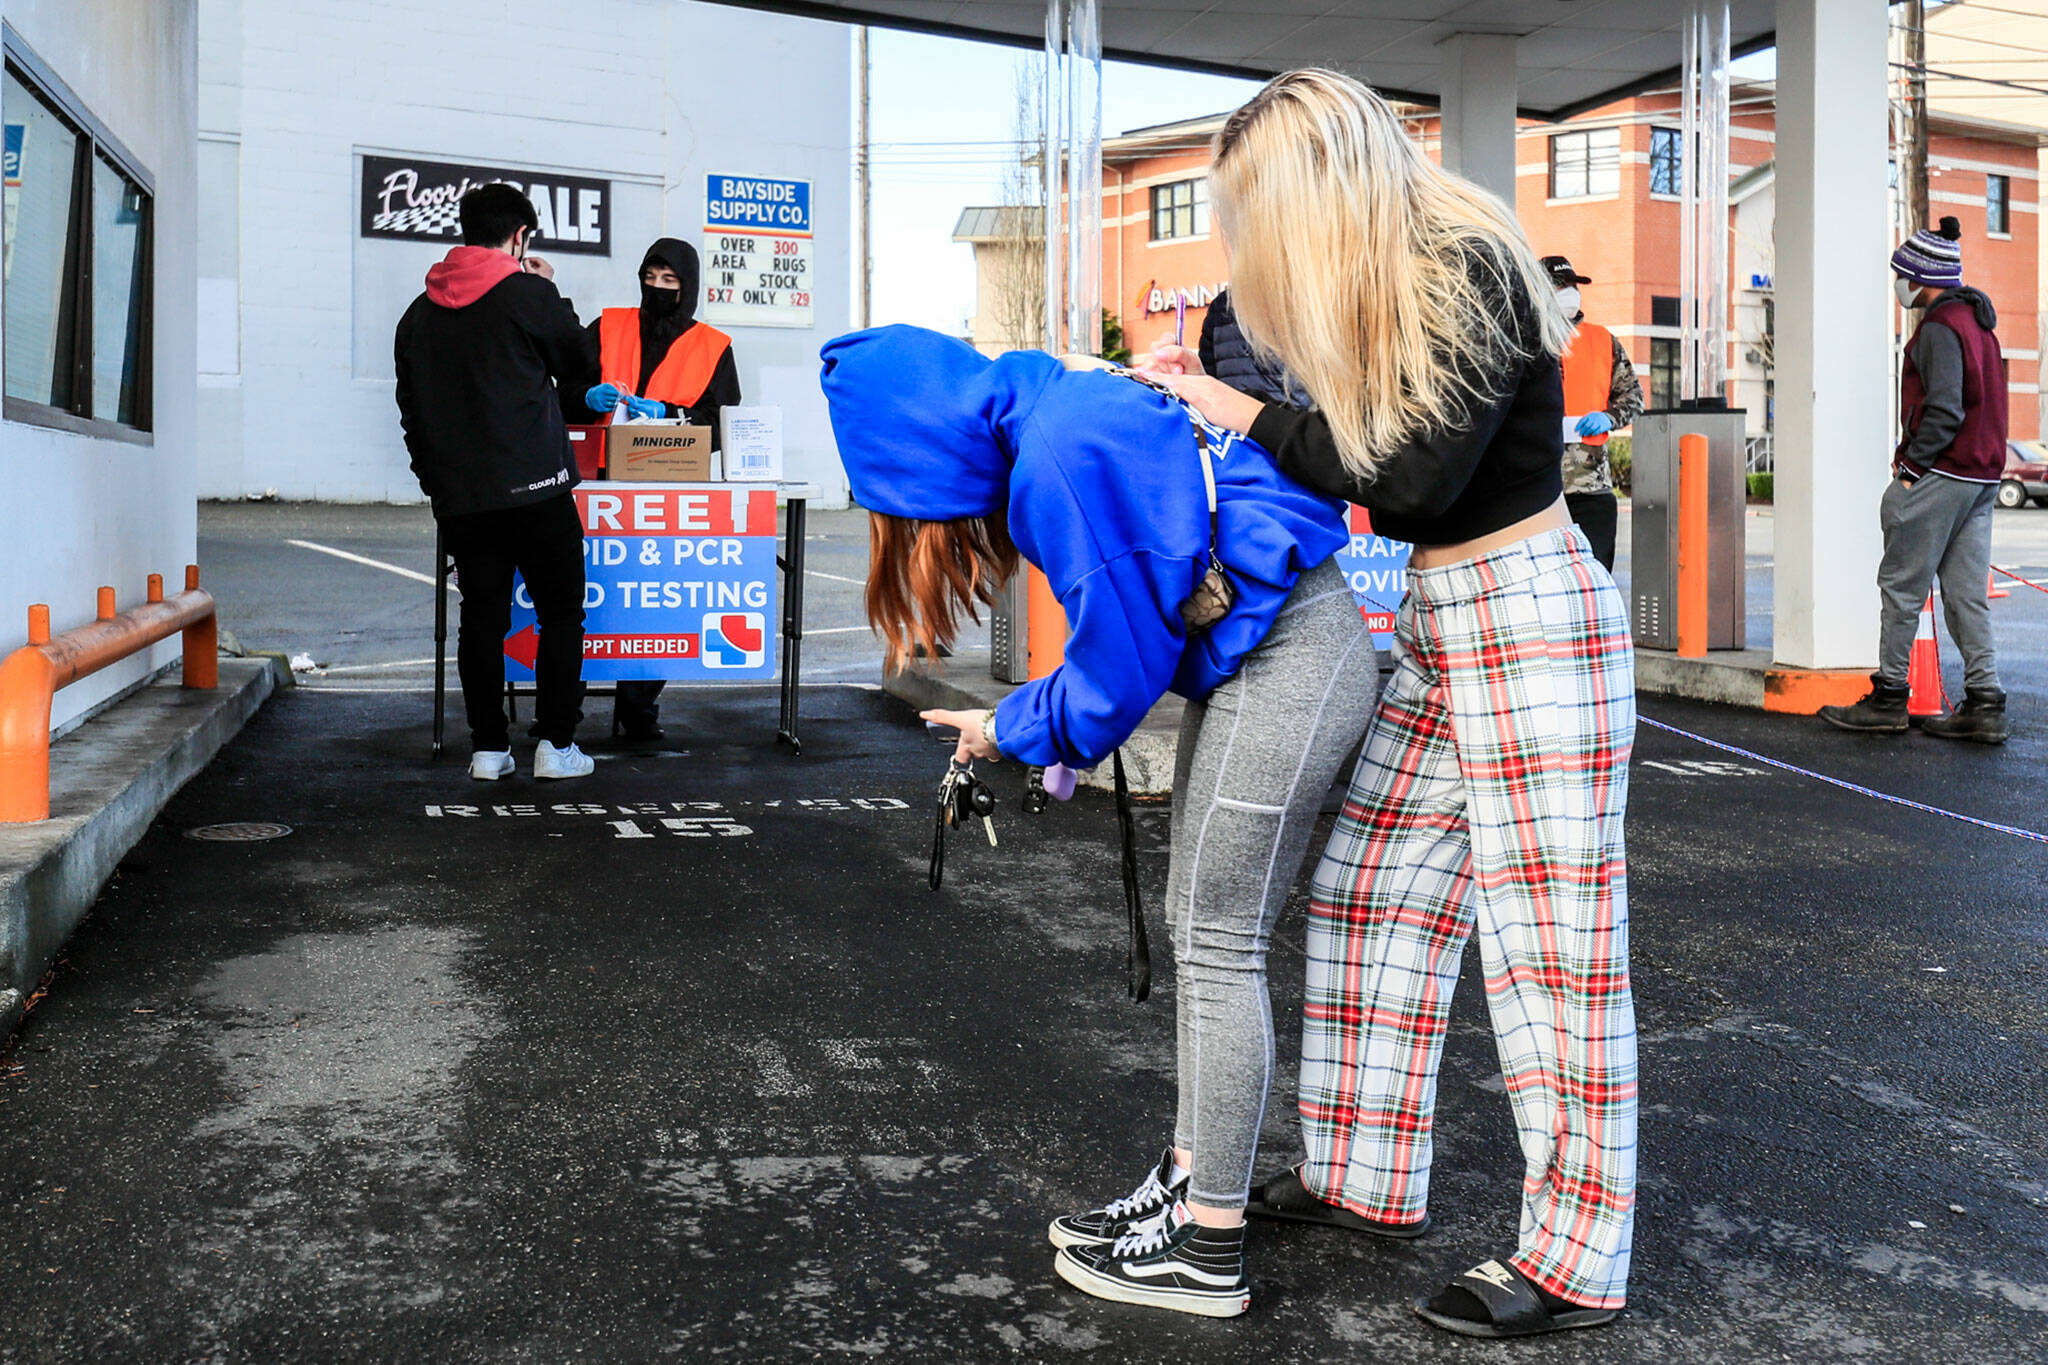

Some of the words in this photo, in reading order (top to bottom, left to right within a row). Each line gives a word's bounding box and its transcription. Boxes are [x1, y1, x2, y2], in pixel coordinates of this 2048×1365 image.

[722, 179, 796, 203] BAYSIDE
[503, 181, 601, 244] ALE
[709, 200, 777, 223] SUPPLY
[778, 205, 808, 225] CO.
[721, 237, 755, 253] OVER
[774, 240, 799, 255] 300
[712, 254, 747, 269] AREA
[773, 257, 806, 273] RUGS
[722, 272, 735, 286] IN
[759, 273, 799, 289] STOCK
[708, 288, 733, 303] 5X7
[743, 289, 776, 304] ONLY
[790, 292, 810, 306] $29
[632, 437, 696, 447] MINIGRIP
[573, 494, 711, 530] REE
[638, 539, 662, 566] &
[674, 539, 744, 566] PCR
[1342, 570, 1409, 593] OVI
[617, 581, 768, 608] TESTING
[1368, 617, 1388, 629] NO
[582, 639, 615, 654] PPT
[620, 639, 689, 654] NEEDED
[606, 817, 754, 838] 15
